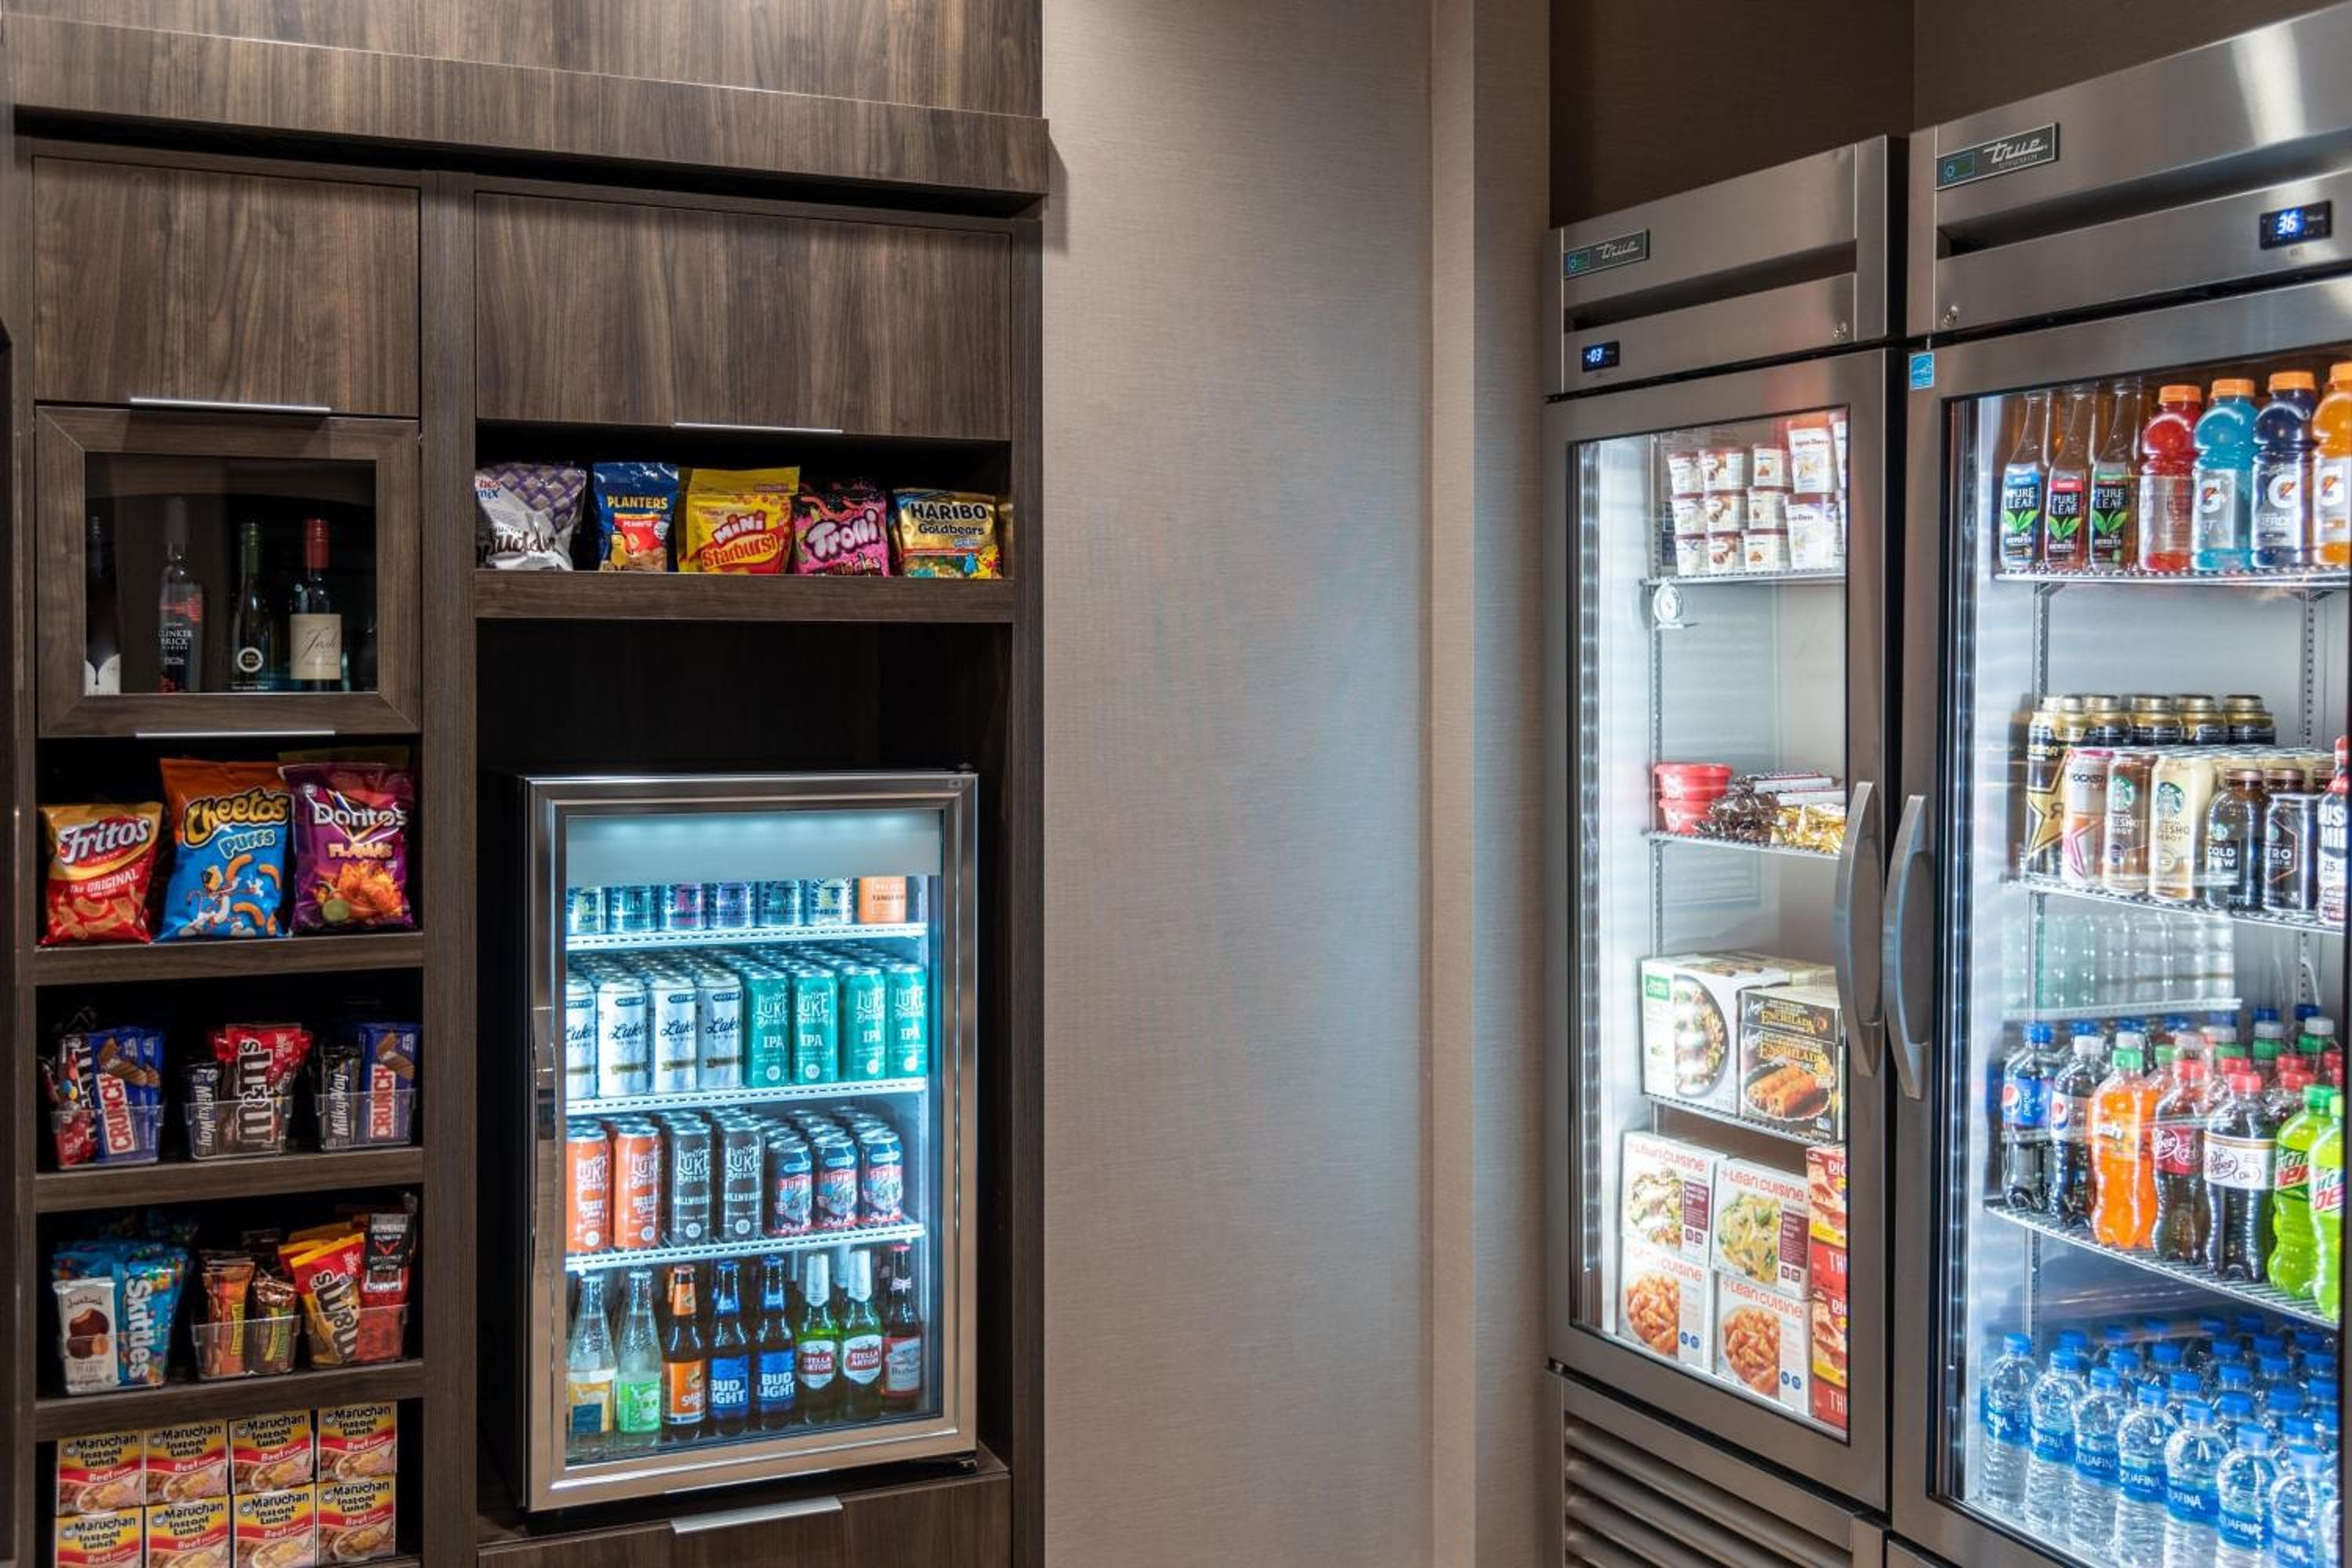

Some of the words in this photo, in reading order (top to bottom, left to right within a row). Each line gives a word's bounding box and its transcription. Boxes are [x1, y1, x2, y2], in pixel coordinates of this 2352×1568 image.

[1984, 139, 2044, 164] True
[2277, 209, 2297, 234] 36
[1596, 241, 1639, 260] True
[608, 496, 668, 510] PLANTERS
[910, 503, 988, 521] HARIBO
[805, 509, 880, 559] Trolli
[919, 523, 985, 536] Goldbears
[701, 535, 779, 566] Starburst
[185, 790, 289, 846] Cheetos
[314, 804, 408, 827] Doritos
[60, 819, 150, 865] Fritos
[219, 829, 275, 859] PUFFS
[87, 869, 139, 894] ORIGINAL
[764, 1036, 785, 1048] IPA
[800, 1034, 823, 1047] IPA
[372, 1068, 394, 1137] CRUNCH
[100, 1076, 132, 1152] CRUNCH
[126, 1279, 154, 1377] Skittles
[761, 1371, 792, 1386] BUD
[711, 1389, 746, 1404] IGHT
[757, 1382, 795, 1398] LIGHT
[335, 1405, 391, 1420] Maruchan
[248, 1414, 305, 1430] Maruchan
[339, 1417, 377, 1428] Instant
[162, 1424, 221, 1440] Maruchan
[252, 1428, 292, 1439] Instant
[343, 1427, 374, 1436] Lunch
[76, 1434, 138, 1450] Maruchan
[166, 1438, 207, 1449] Instant
[257, 1438, 288, 1448] Lunch
[80, 1448, 122, 1460] Instant
[171, 1448, 203, 1457] Lunch
[85, 1457, 118, 1468] Lunch
[333, 1480, 390, 1495] Maruchan
[251, 1491, 310, 1509] Maruchan
[337, 1494, 376, 1505] Instant
[165, 1502, 224, 1519] Maruchan
[256, 1505, 296, 1518] Instant
[341, 1503, 372, 1513] Lunch
[74, 1515, 136, 1531] Maruchan
[169, 1515, 209, 1528] Instant
[260, 1515, 292, 1525] Lunch
[79, 1530, 121, 1542] Instant
[173, 1526, 206, 1536] Lunch
[83, 1540, 117, 1550] Lunch
